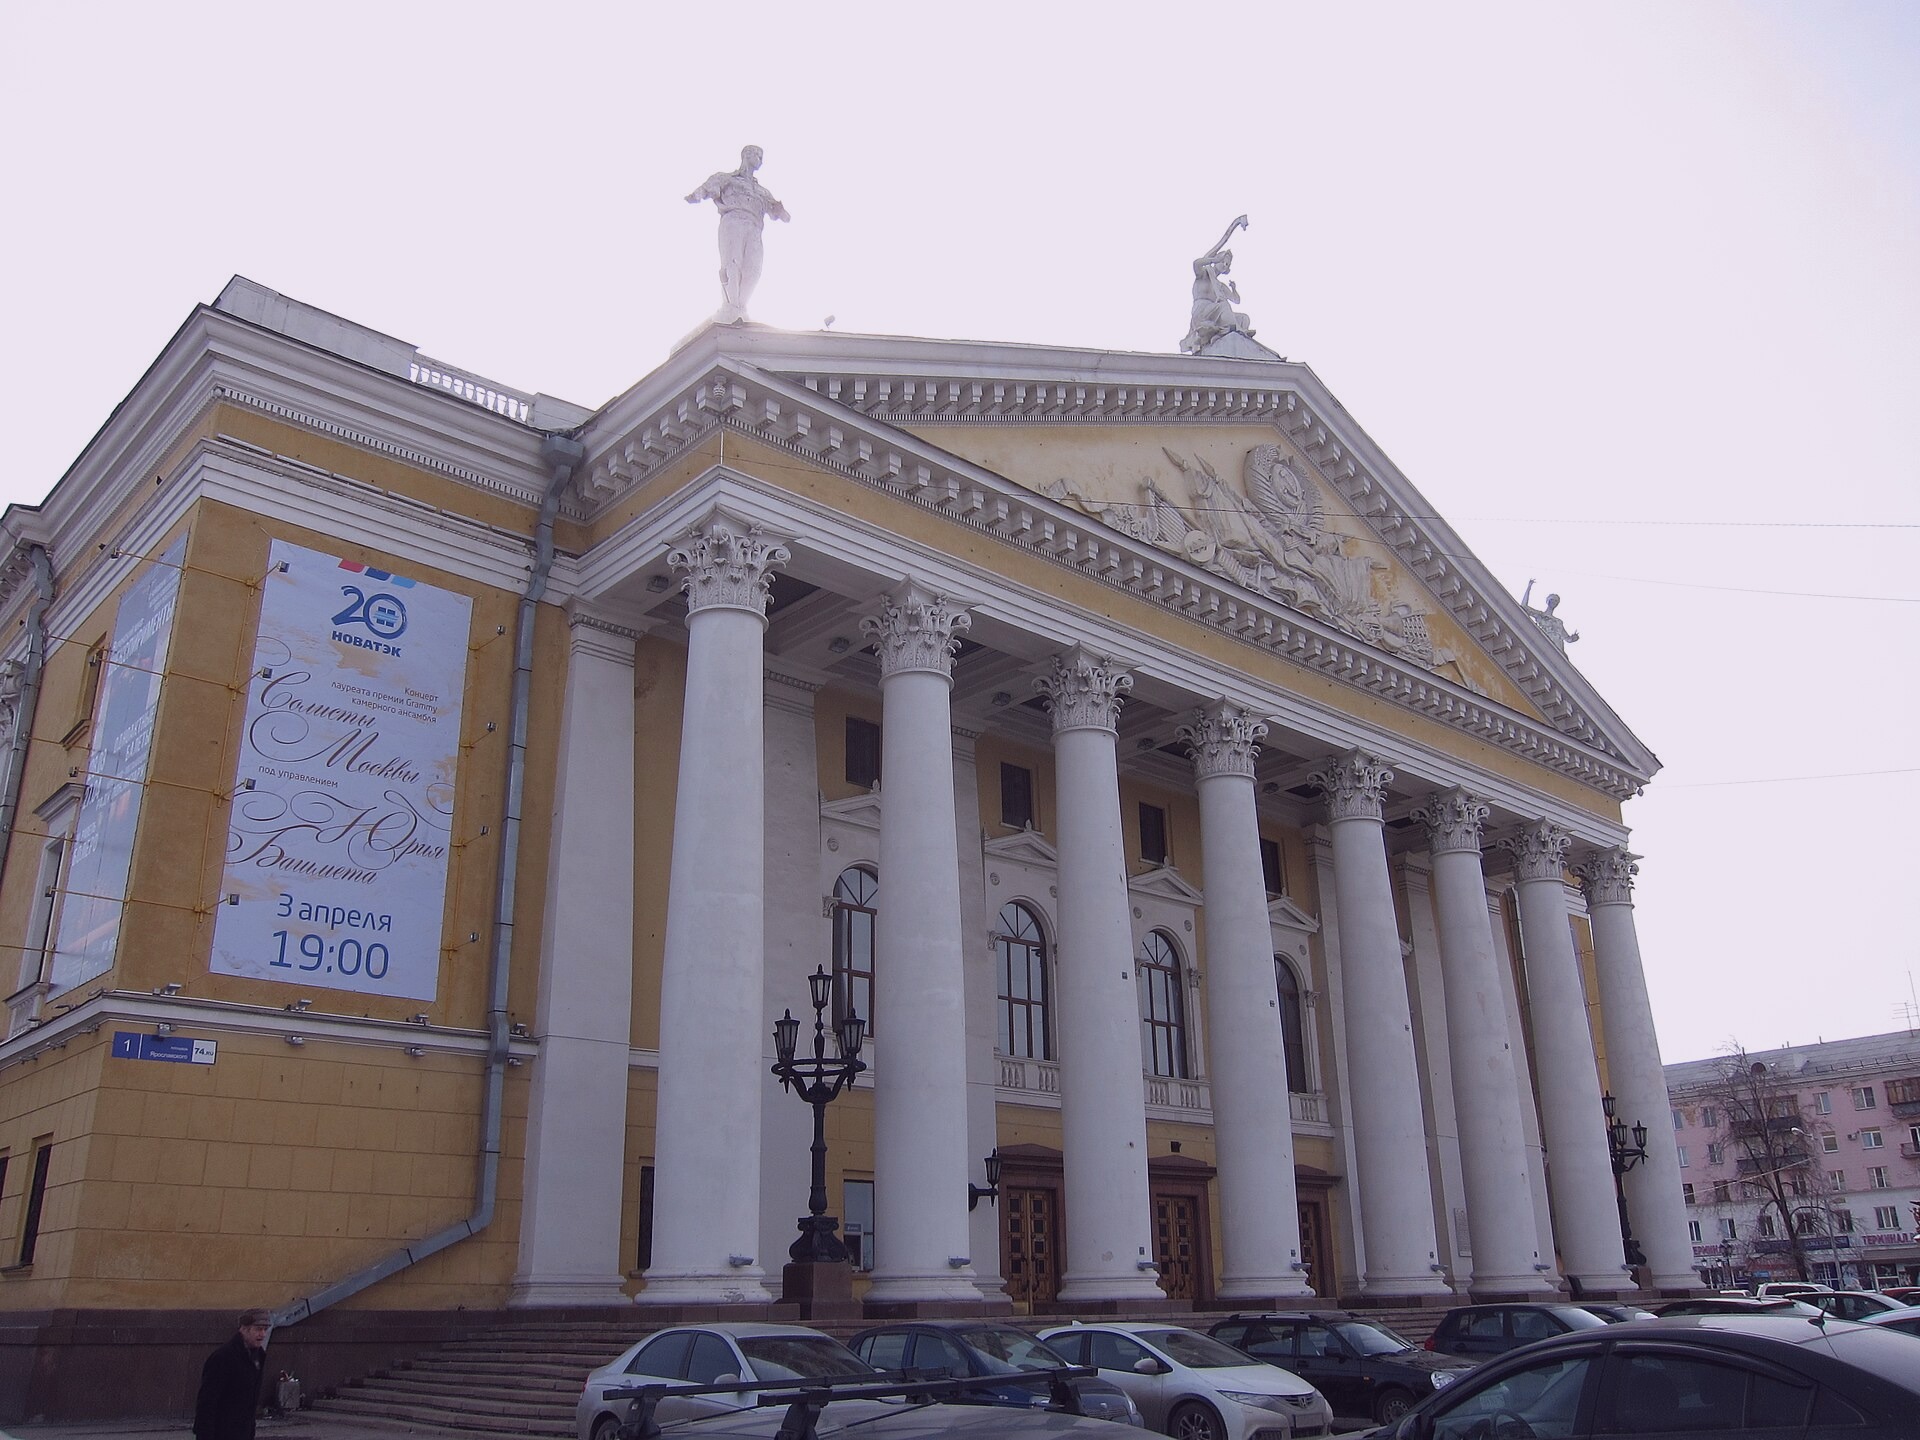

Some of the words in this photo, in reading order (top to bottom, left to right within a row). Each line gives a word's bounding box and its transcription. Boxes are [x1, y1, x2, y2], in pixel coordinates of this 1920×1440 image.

[331, 630, 402, 658] НОВАТЭК
[259, 671, 376, 729] Солисты
[331, 681, 371, 697] лауреата
[372, 692, 405, 705] премии
[406, 698, 439, 715] Grammy
[351, 697, 397, 713] камерного
[398, 708, 437, 724] ансамбля
[404, 687, 439, 702] Концерт
[258, 765, 276, 776] под
[277, 769, 339, 788] управлением
[290, 789, 445, 870] Юрия
[226, 824, 379, 885] Башмета
[276, 893, 293, 918] 3
[298, 901, 393, 933] апреля
[269, 930, 389, 980] 19:00
[123, 1038, 132, 1052] 1
